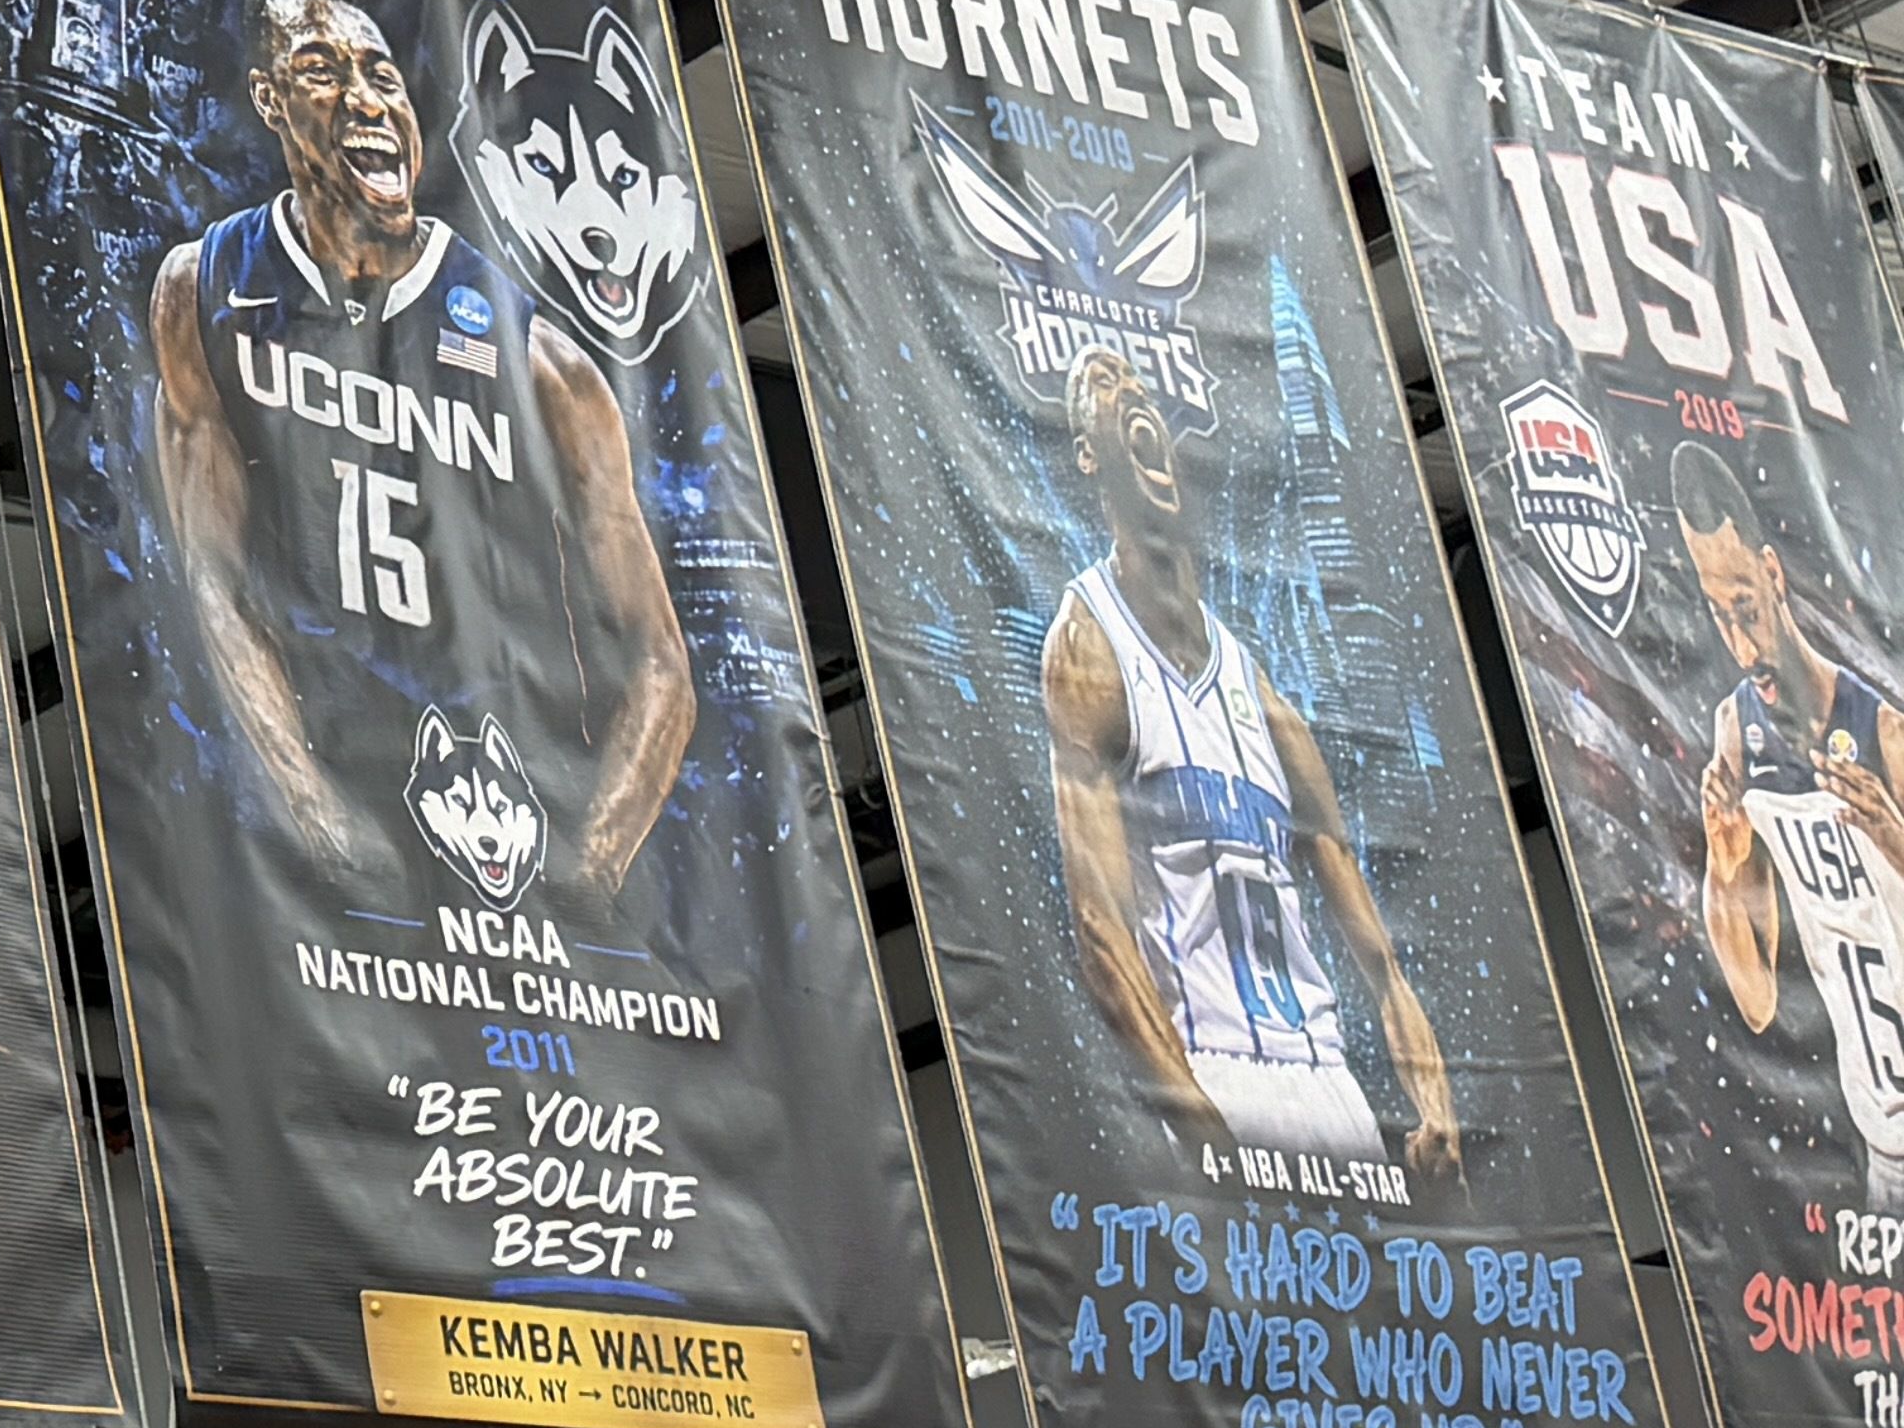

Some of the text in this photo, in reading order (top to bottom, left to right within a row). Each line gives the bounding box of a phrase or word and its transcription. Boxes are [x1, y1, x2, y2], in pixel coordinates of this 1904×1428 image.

[985, 95, 1135, 174] 2011-2019
[1515, 55, 1711, 172] TEAM
[1037, 284, 1160, 332] CHARLOTTE
[1493, 142, 1849, 425] USA
[235, 332, 515, 483] UCONN
[1674, 388, 1743, 440] 2019
[1519, 420, 1609, 491] USA
[331, 458, 433, 628] 15
[1521, 496, 1633, 534] BASKETBALL
[1774, 816, 1876, 902] USA
[437, 907, 572, 969] NCAA
[295, 943, 722, 1042] NATIONAL CHAMPION
[481, 1025, 576, 1077] 2011
[524, 1091, 663, 1158] YOUR
[412, 1145, 699, 1221] ABSOLUTE
[1238, 1145, 1291, 1193] NBA
[1298, 1153, 1412, 1207] ALL-STAR
[1226, 1217, 1372, 1313] HARD
[1384, 1237, 1454, 1320] TO
[1465, 1246, 1583, 1336] BEAT
[439, 1315, 748, 1383] KEMBA WALKER
[1068, 1294, 1637, 1427] A PLAYER WHO NEVER
[449, 1372, 755, 1421] BRONX, NY CONCORD, NC
